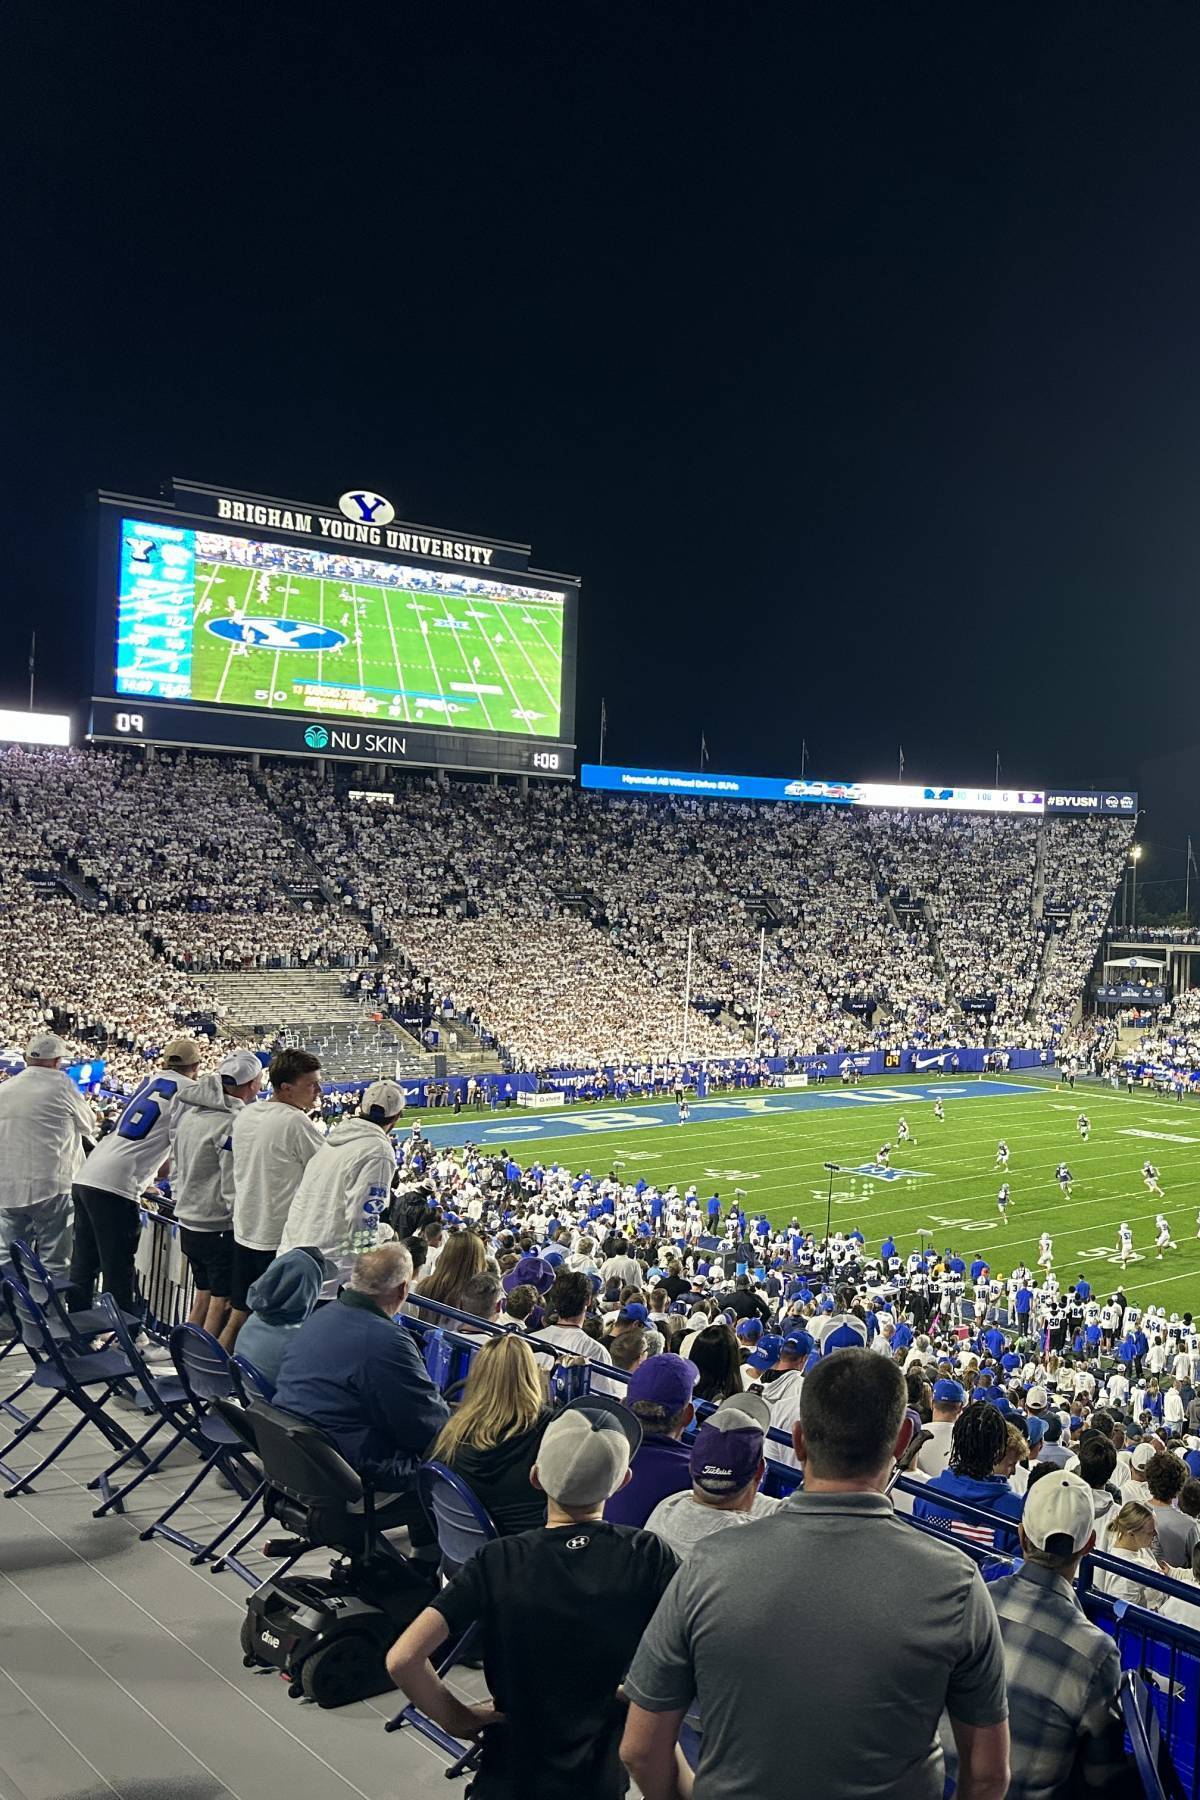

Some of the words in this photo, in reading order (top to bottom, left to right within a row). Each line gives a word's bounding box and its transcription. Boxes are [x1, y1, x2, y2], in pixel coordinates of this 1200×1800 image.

[350, 494, 385, 522] Y
[217, 499, 312, 532] BRIGHAM
[318, 517, 381, 545] YOUNG
[386, 530, 493, 565] UNIVERSITY
[115, 713, 144, 732] 09
[331, 731, 361, 750] NU
[365, 734, 406, 755] SKIN
[1047, 796, 1097, 807] #BYUSN
[886, 1055, 899, 1066] 09
[1127, 1312, 1137, 1321] 10
[702, 1465, 733, 1475] Titleist
[261, 1630, 280, 1648] drive
